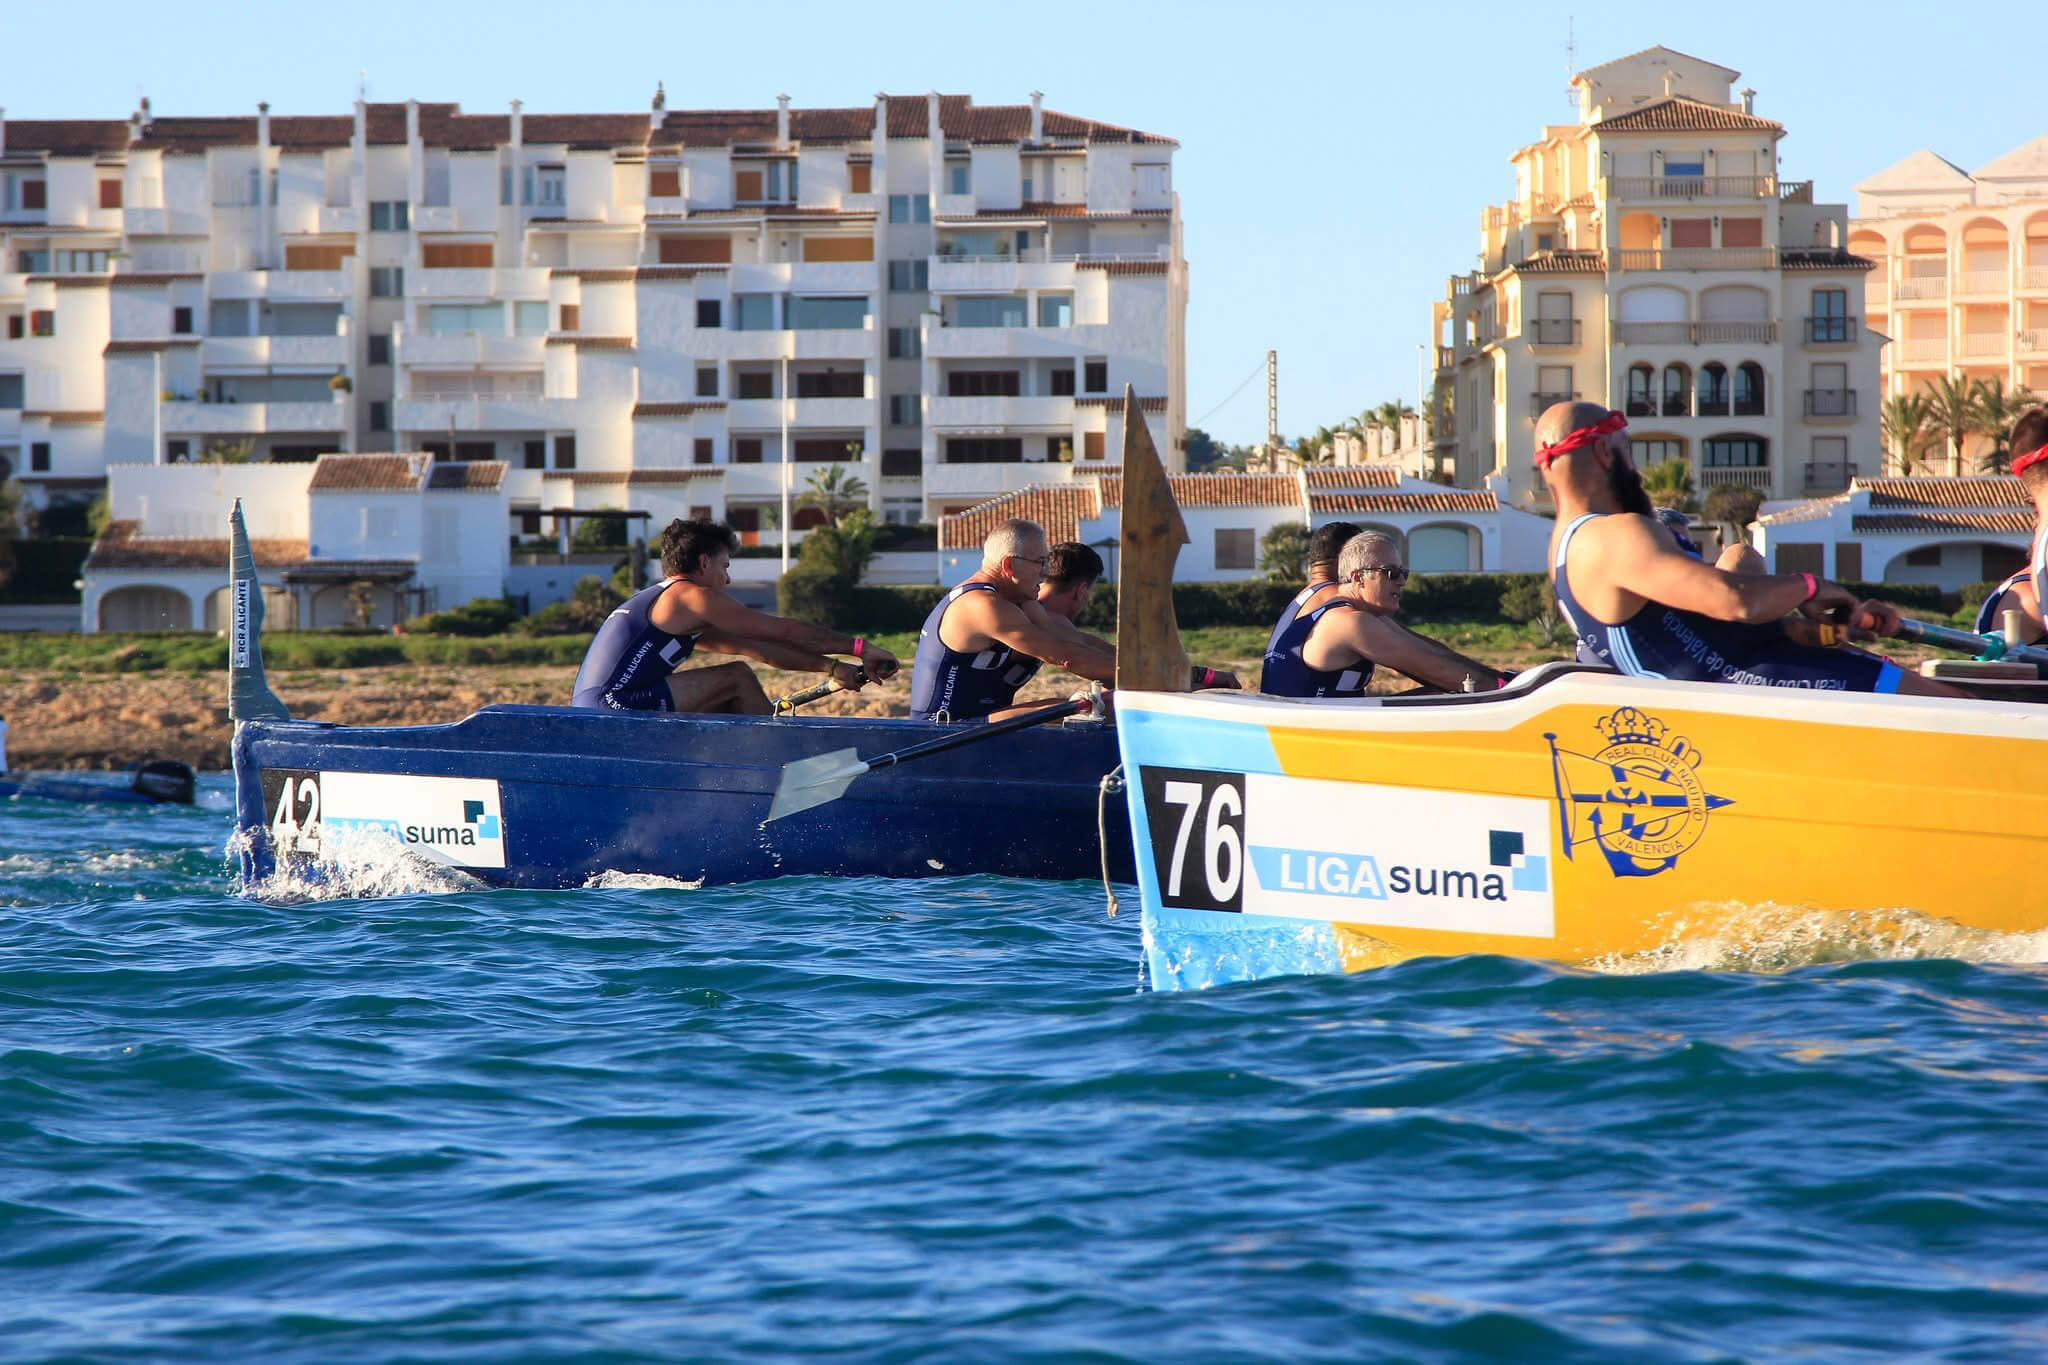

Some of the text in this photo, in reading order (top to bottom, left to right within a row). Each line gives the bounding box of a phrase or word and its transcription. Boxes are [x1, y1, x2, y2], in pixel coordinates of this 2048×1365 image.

[238, 581, 246, 653] RCR ALICANTE
[1662, 610, 1709, 664] Valencia
[619, 672, 632, 684] DE
[627, 640, 653, 673] ALICANTE
[1706, 651, 1724, 673] de
[940, 665, 959, 711] DE ALICANTE
[1605, 746, 1638, 762] REAL
[1643, 746, 1679, 769] CLUB
[270, 776, 320, 850] 42
[405, 825, 477, 846] suma
[1165, 781, 1243, 903] 76
[1616, 836, 1685, 855] VALENCIA
[1279, 852, 1508, 902] LIGA suma
